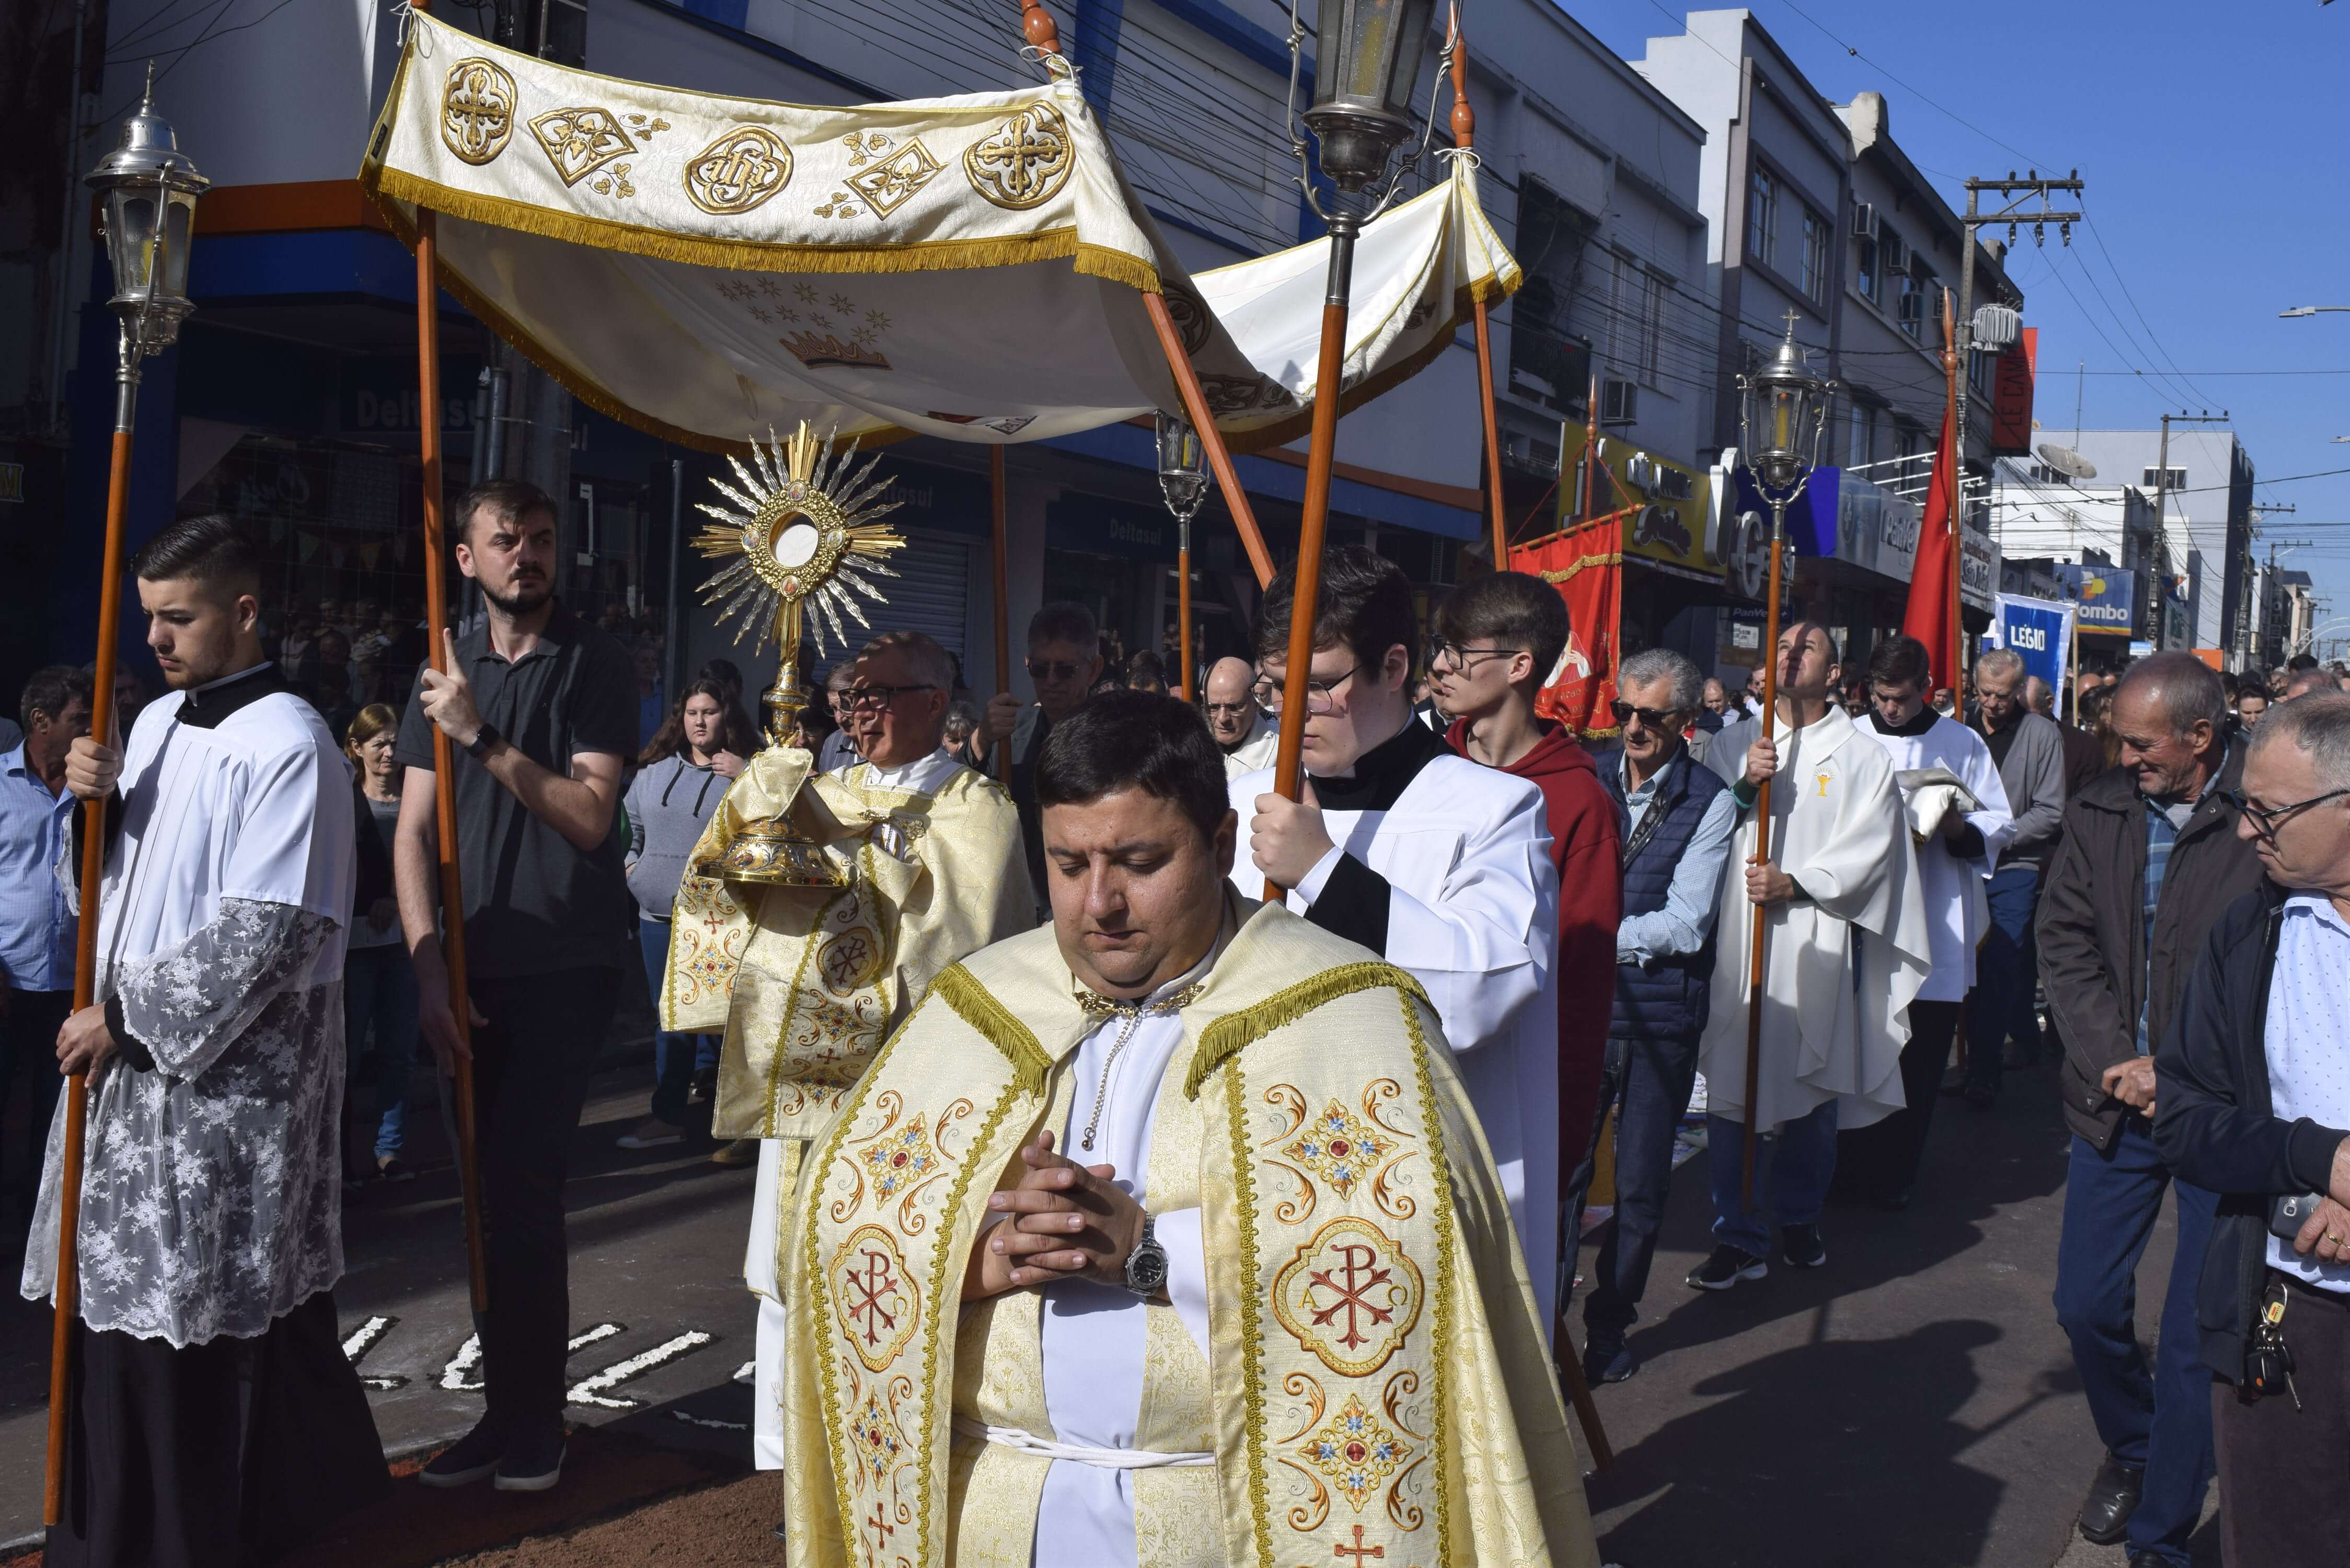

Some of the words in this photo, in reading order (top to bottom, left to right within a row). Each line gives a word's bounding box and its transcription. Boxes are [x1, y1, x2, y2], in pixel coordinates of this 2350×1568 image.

[357, 389, 477, 428] Delts
[1109, 517, 1161, 546] Deltasul
[1882, 509, 1915, 553] PanVe
[1732, 607, 1768, 617] PanVe
[2065, 598, 2128, 620] lombo
